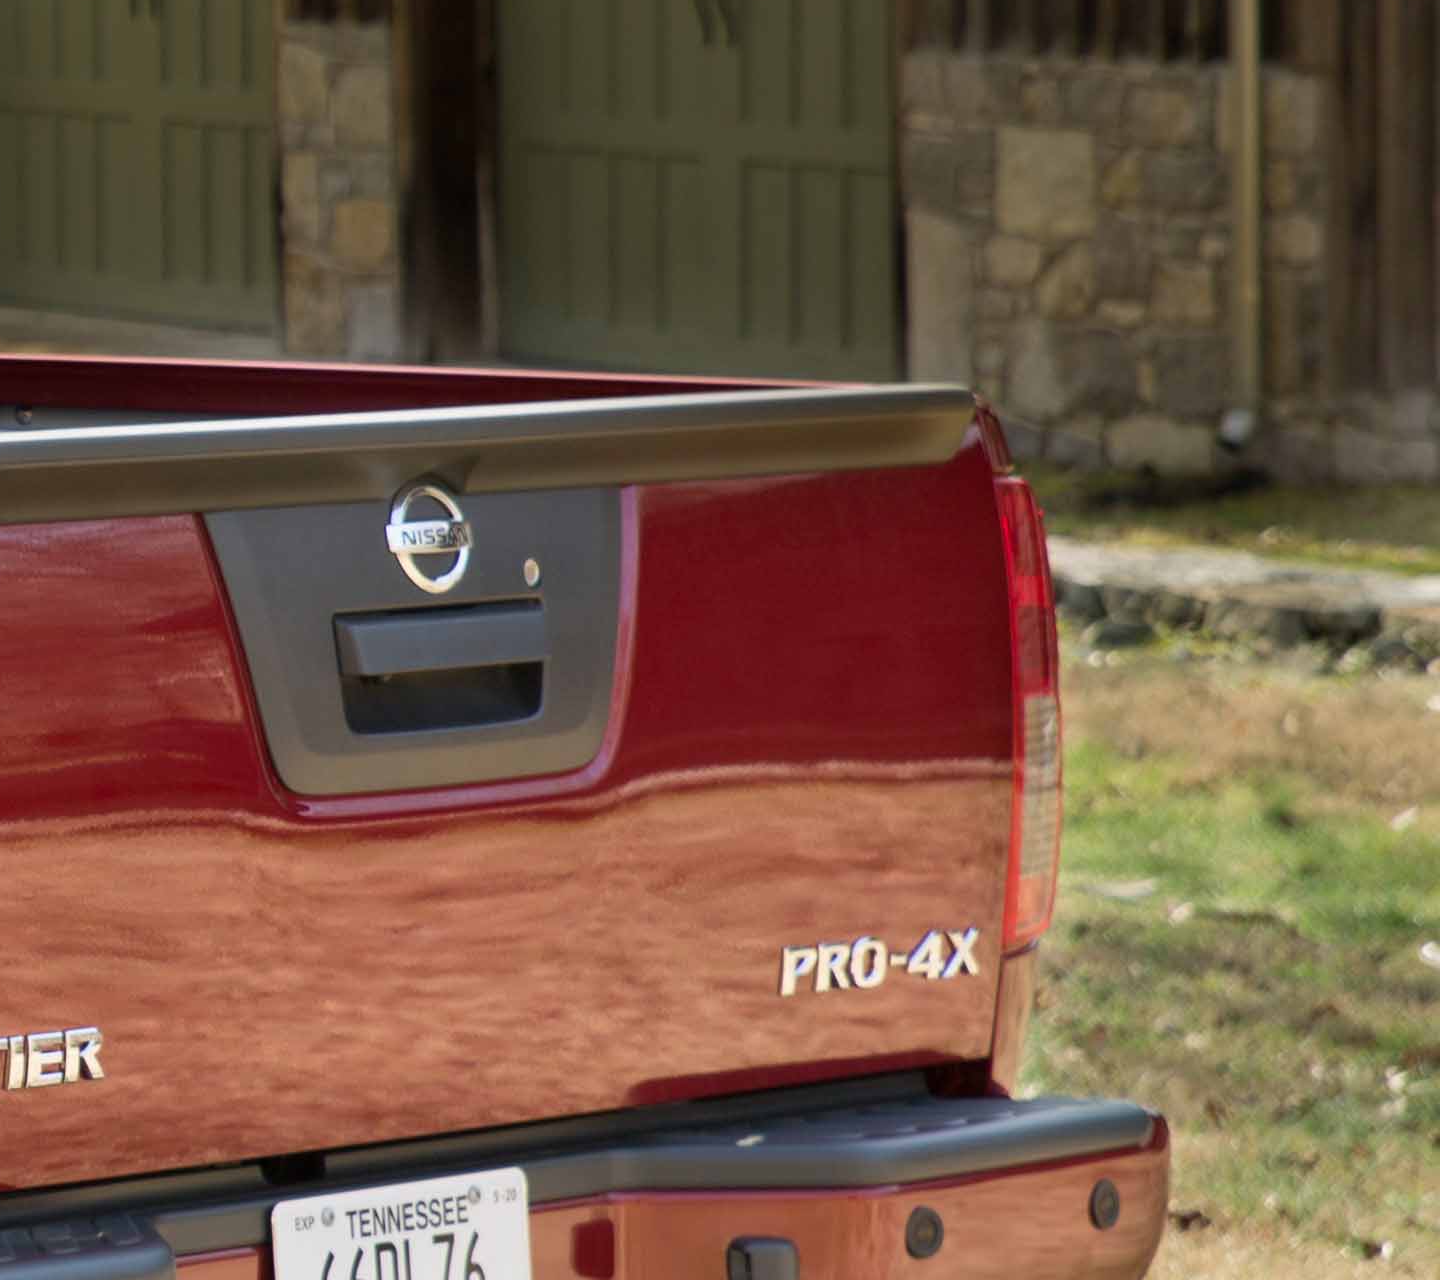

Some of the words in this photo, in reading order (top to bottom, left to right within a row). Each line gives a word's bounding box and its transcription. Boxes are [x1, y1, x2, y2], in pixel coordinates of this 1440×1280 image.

[402, 526, 469, 546] NISSAN
[780, 927, 979, 997] PRO-4X
[294, 1215, 315, 1232] EXP
[346, 1196, 469, 1239] TENNESSEE
